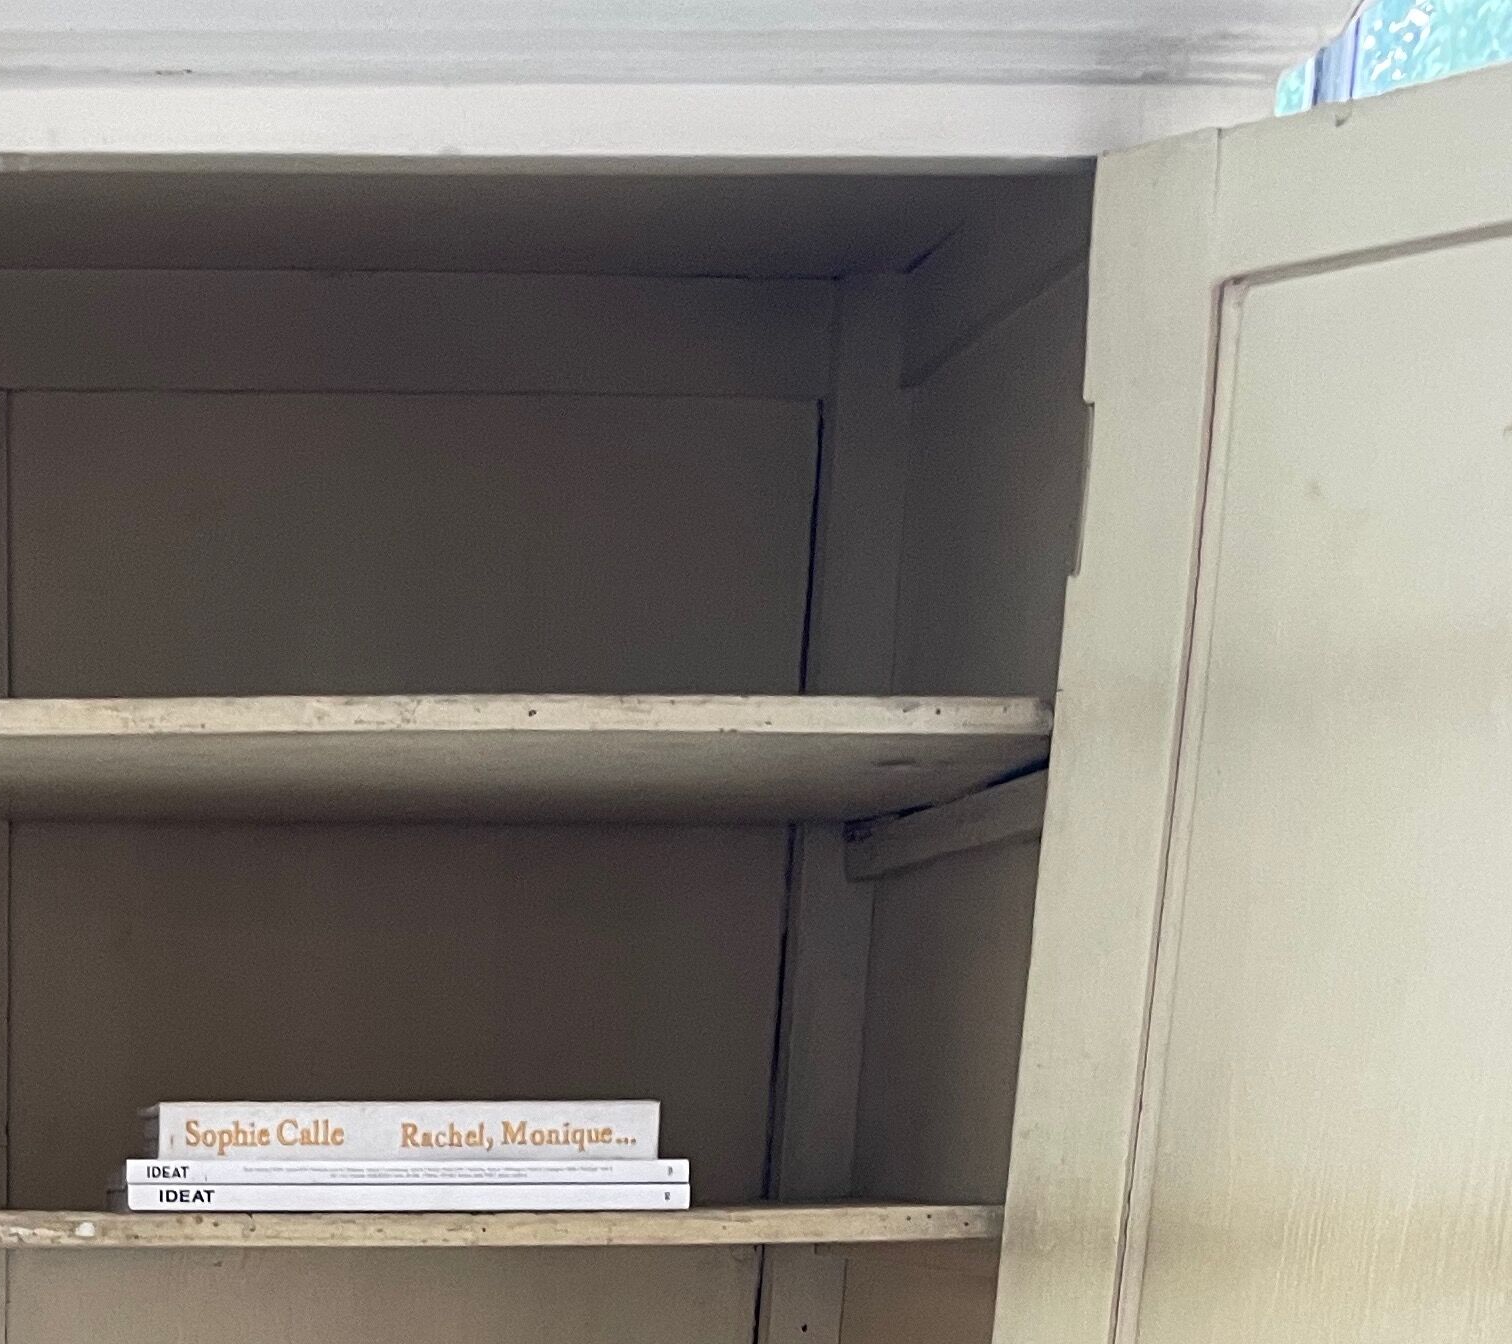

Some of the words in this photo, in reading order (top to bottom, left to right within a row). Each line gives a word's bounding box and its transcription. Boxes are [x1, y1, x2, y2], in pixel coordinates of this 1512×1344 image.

[185, 1119, 271, 1156] Sophie
[276, 1118, 345, 1147] Calle
[400, 1121, 494, 1151] Rachel,
[500, 1119, 637, 1152] Monique...
[146, 1165, 190, 1179] IDEAT
[158, 1189, 216, 1203] IDEAT
